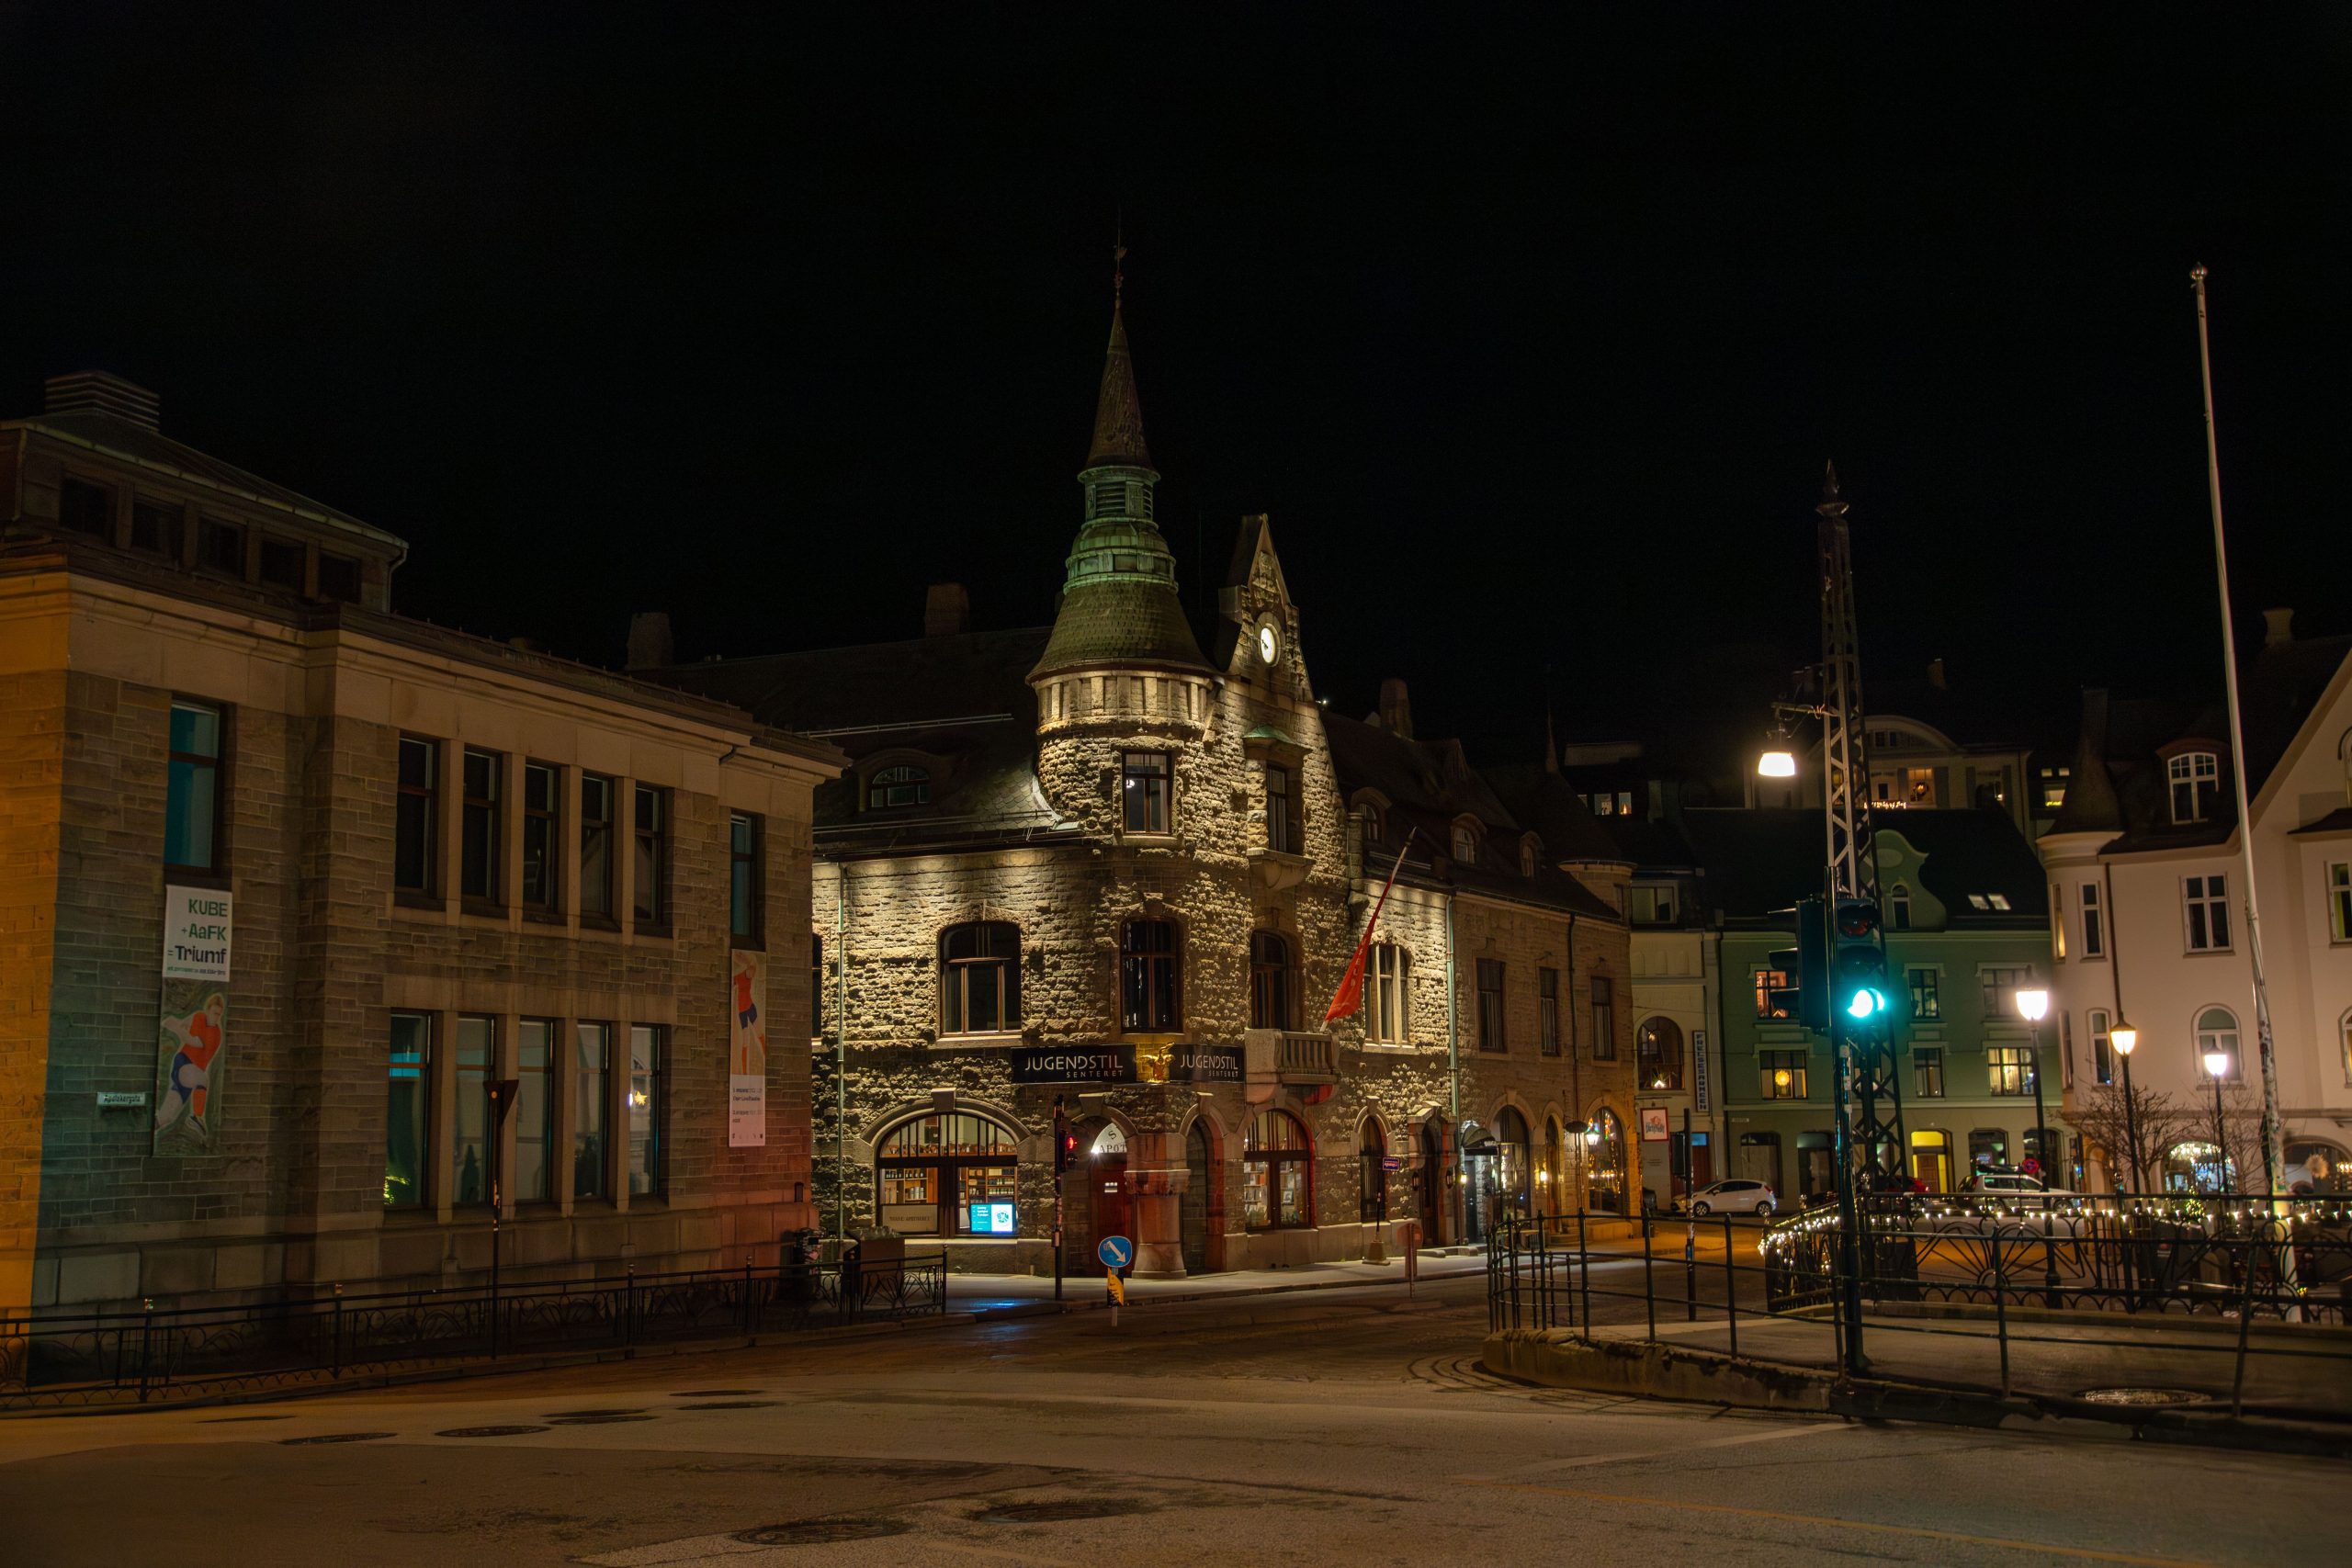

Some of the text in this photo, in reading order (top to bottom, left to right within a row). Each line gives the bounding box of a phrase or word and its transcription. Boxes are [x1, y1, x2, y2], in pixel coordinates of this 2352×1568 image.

[188, 898, 228, 918] KUBE
[1024, 1055, 1124, 1071] JUGENDSTIL
[1180, 1054, 1238, 1070] JUGENDSTIL
[1066, 1069, 1124, 1078] SENTERET
[1208, 1069, 1238, 1077] SENTERET
